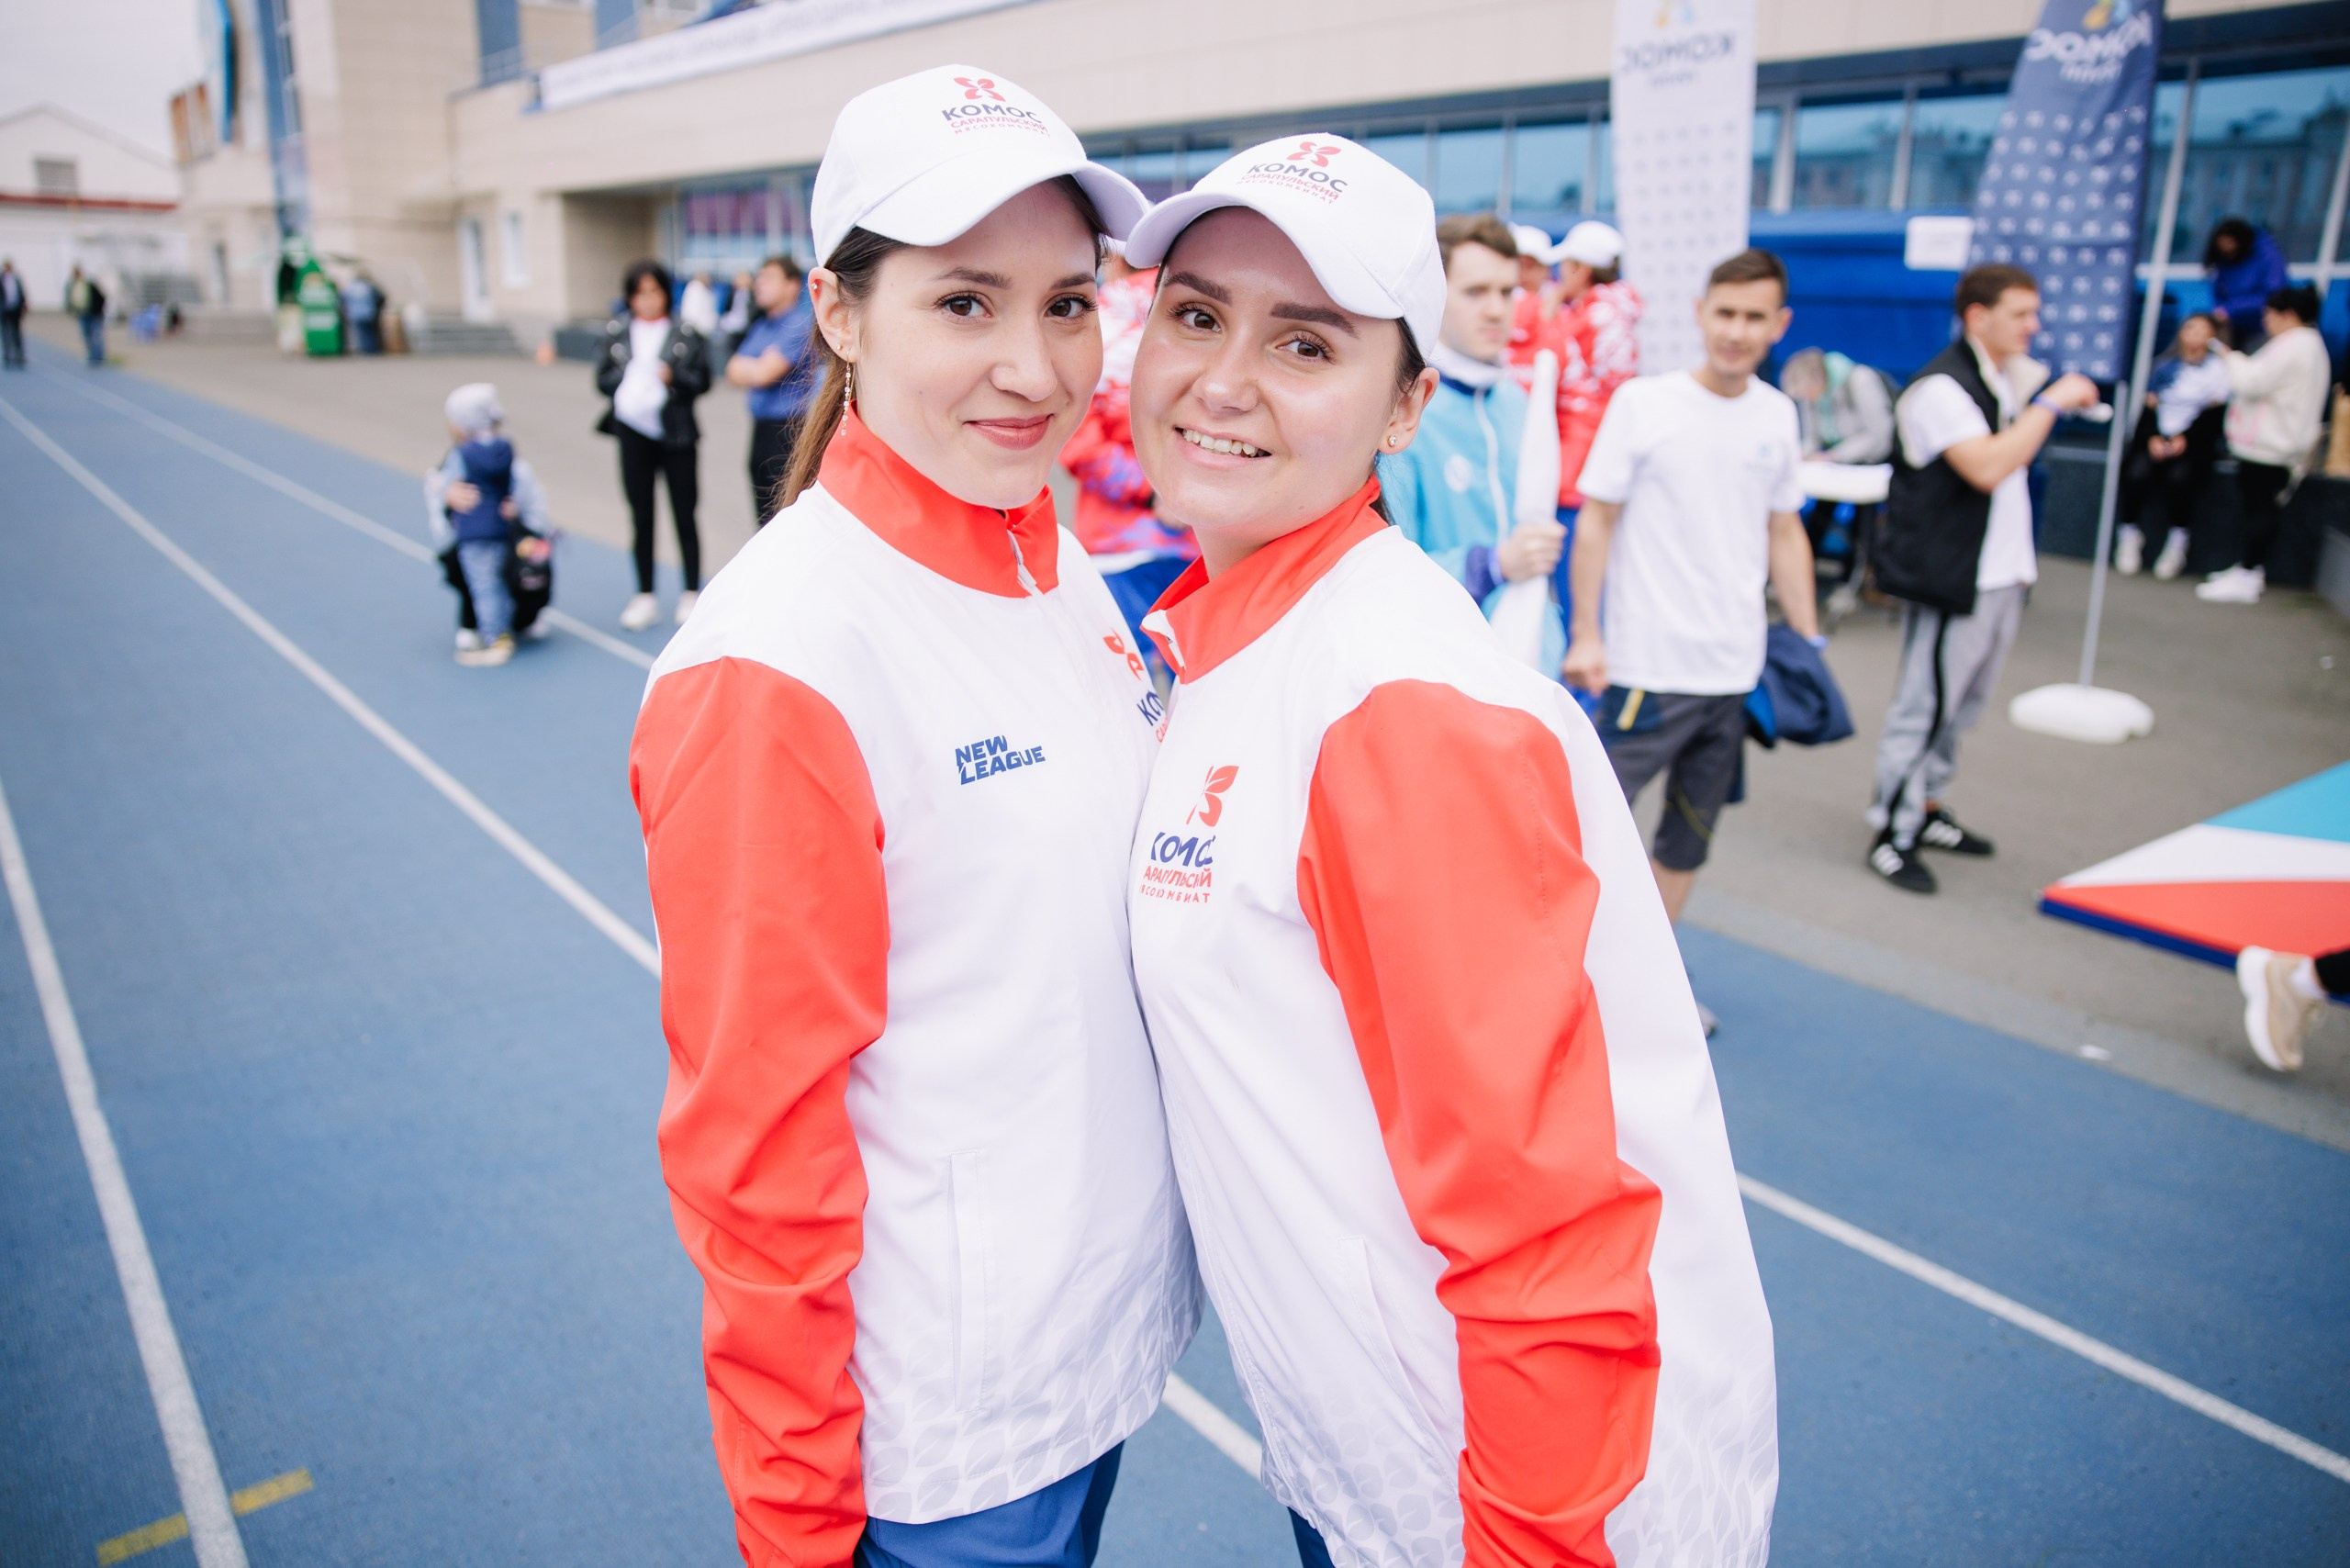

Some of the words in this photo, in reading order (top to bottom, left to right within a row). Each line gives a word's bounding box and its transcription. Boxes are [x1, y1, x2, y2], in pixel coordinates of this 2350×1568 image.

[942, 104, 1042, 123] КОМОС
[951, 116, 1048, 132] САРАПУЛЬСКИЙ
[1241, 173, 1339, 200] САРАПУЛЬСКИЙ
[1248, 162, 1348, 193] КОМОС
[956, 735, 1007, 774] NEW
[961, 745, 1046, 785] LEAGUE
